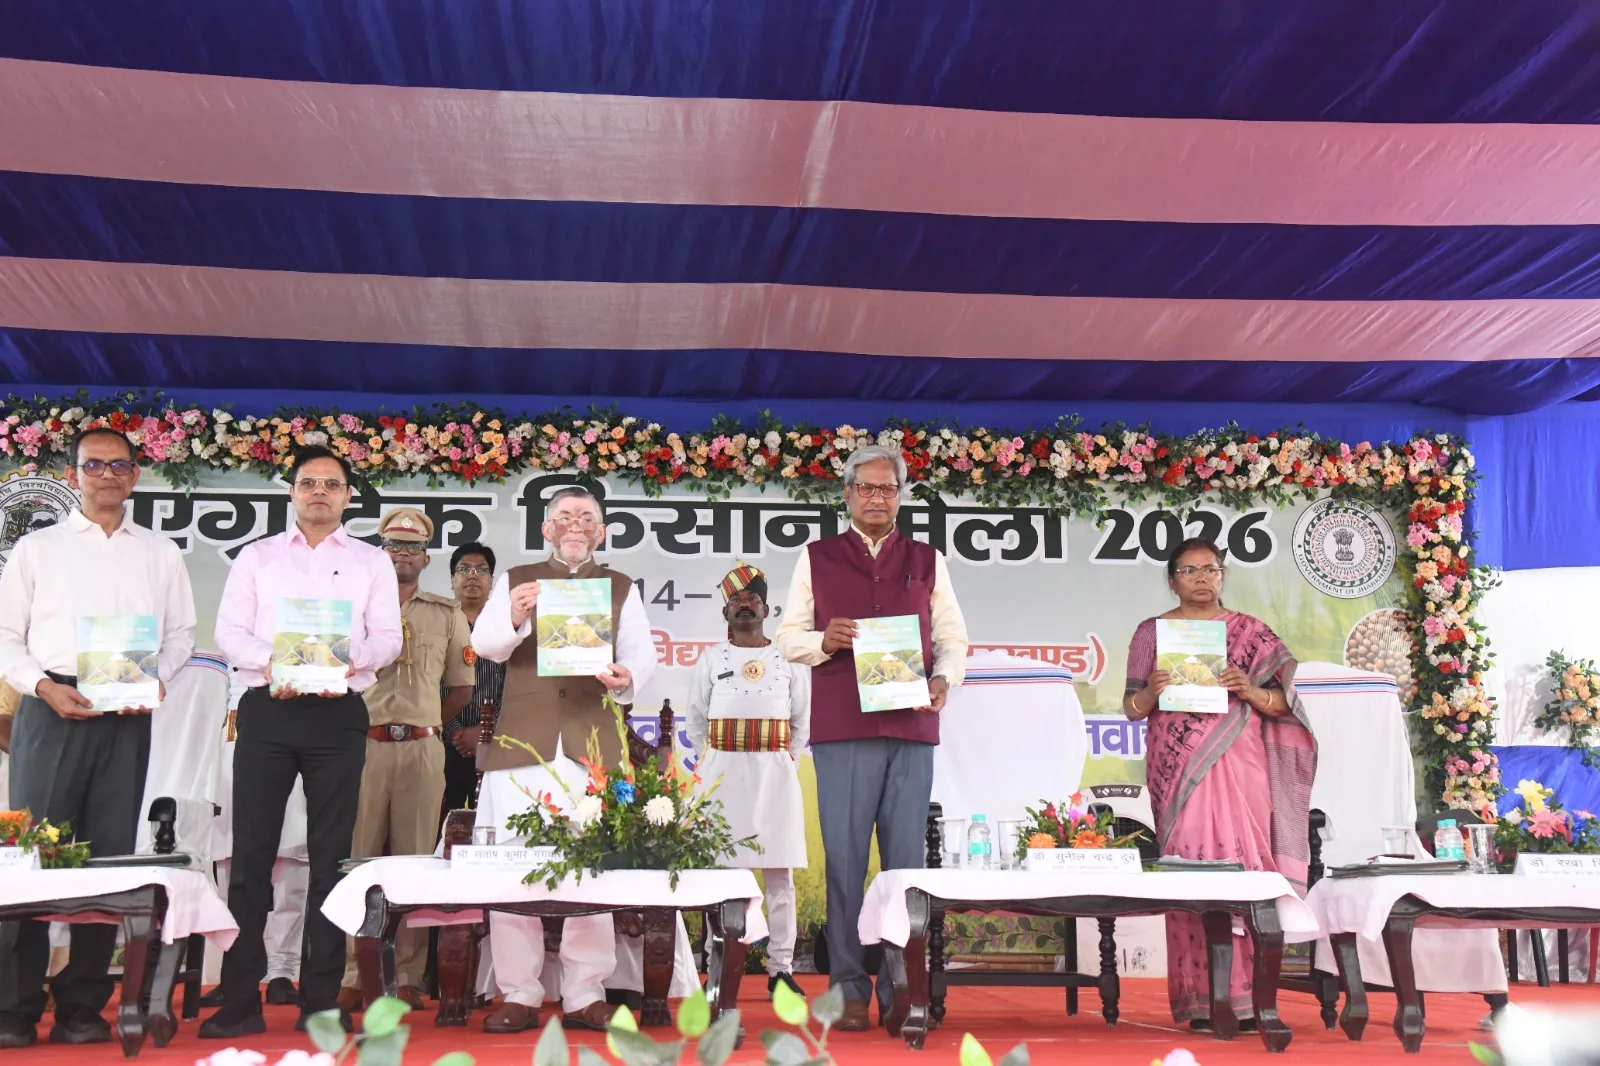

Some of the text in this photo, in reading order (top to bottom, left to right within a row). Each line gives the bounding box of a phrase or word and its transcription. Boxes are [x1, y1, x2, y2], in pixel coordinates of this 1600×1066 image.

[1094, 508, 1273, 562] 2026
[1298, 554, 1342, 594] GOVERNMENT
[1357, 555, 1392, 594] JHARKHAND
[457, 848, 468, 858] श्री
[504, 850, 528, 861] कुमार
[1055, 851, 1085, 864] सुनील
[1556, 857, 1583, 867] रेखा
